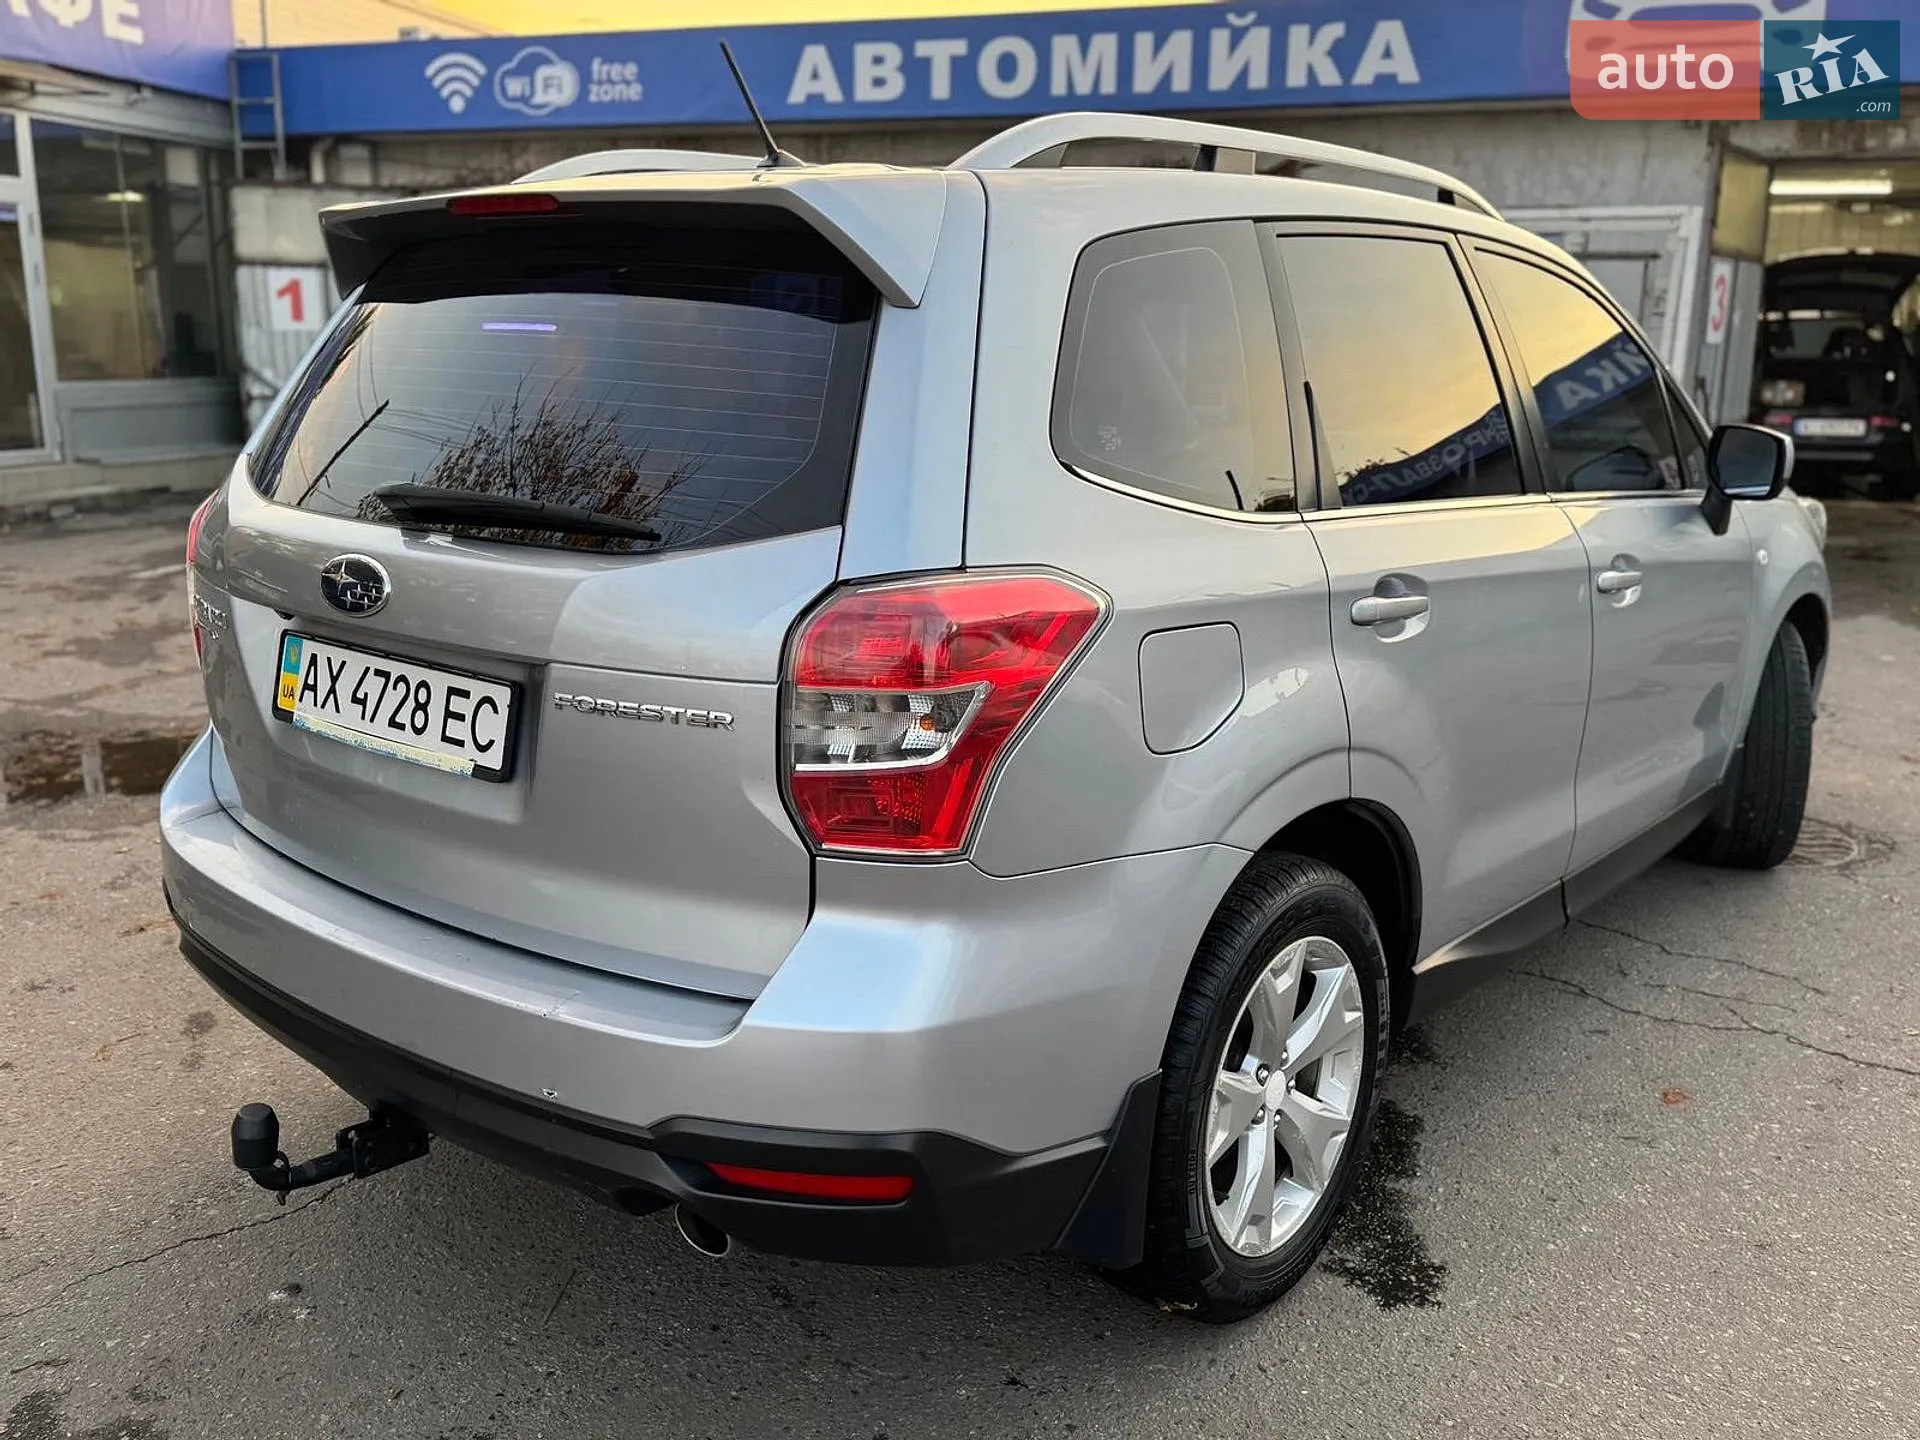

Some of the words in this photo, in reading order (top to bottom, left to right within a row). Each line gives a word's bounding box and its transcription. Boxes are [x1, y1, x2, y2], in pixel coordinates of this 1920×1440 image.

[591, 57, 638, 82] free
[787, 12, 1421, 105] АВТОМИЙКА
[588, 81, 643, 103] zone
[275, 277, 305, 323] 1
[1711, 274, 1728, 333] 3
[282, 686, 296, 700] UA
[299, 652, 347, 714] AX
[350, 665, 432, 736] 4728
[440, 685, 500, 754] EC
[553, 692, 736, 732] FORESTER
